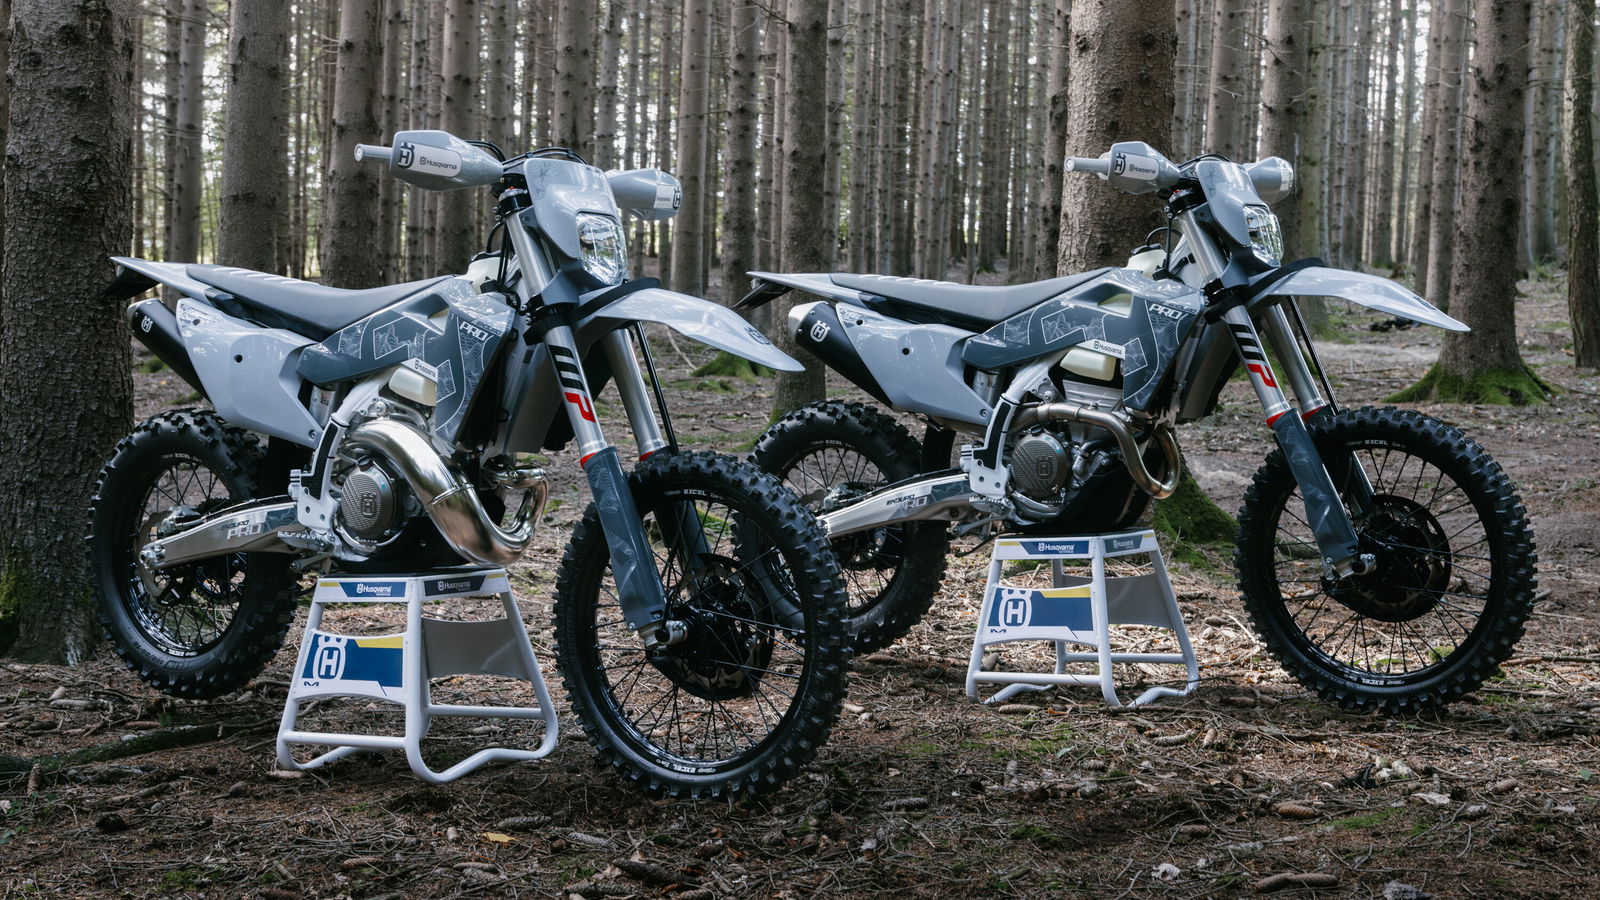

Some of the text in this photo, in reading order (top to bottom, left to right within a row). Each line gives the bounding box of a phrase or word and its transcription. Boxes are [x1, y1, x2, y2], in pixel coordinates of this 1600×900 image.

[426, 158, 457, 170] Husqvarna
[1149, 303, 1183, 320] PRO
[459, 320, 488, 341] PRO
[683, 488, 706, 496] EXCEL
[886, 494, 915, 505] ENDURO
[227, 523, 262, 540] PRO
[1045, 544, 1075, 552] Husqvarna
[363, 585, 392, 593] Husqvarna
[672, 764, 696, 774] EXCEL
